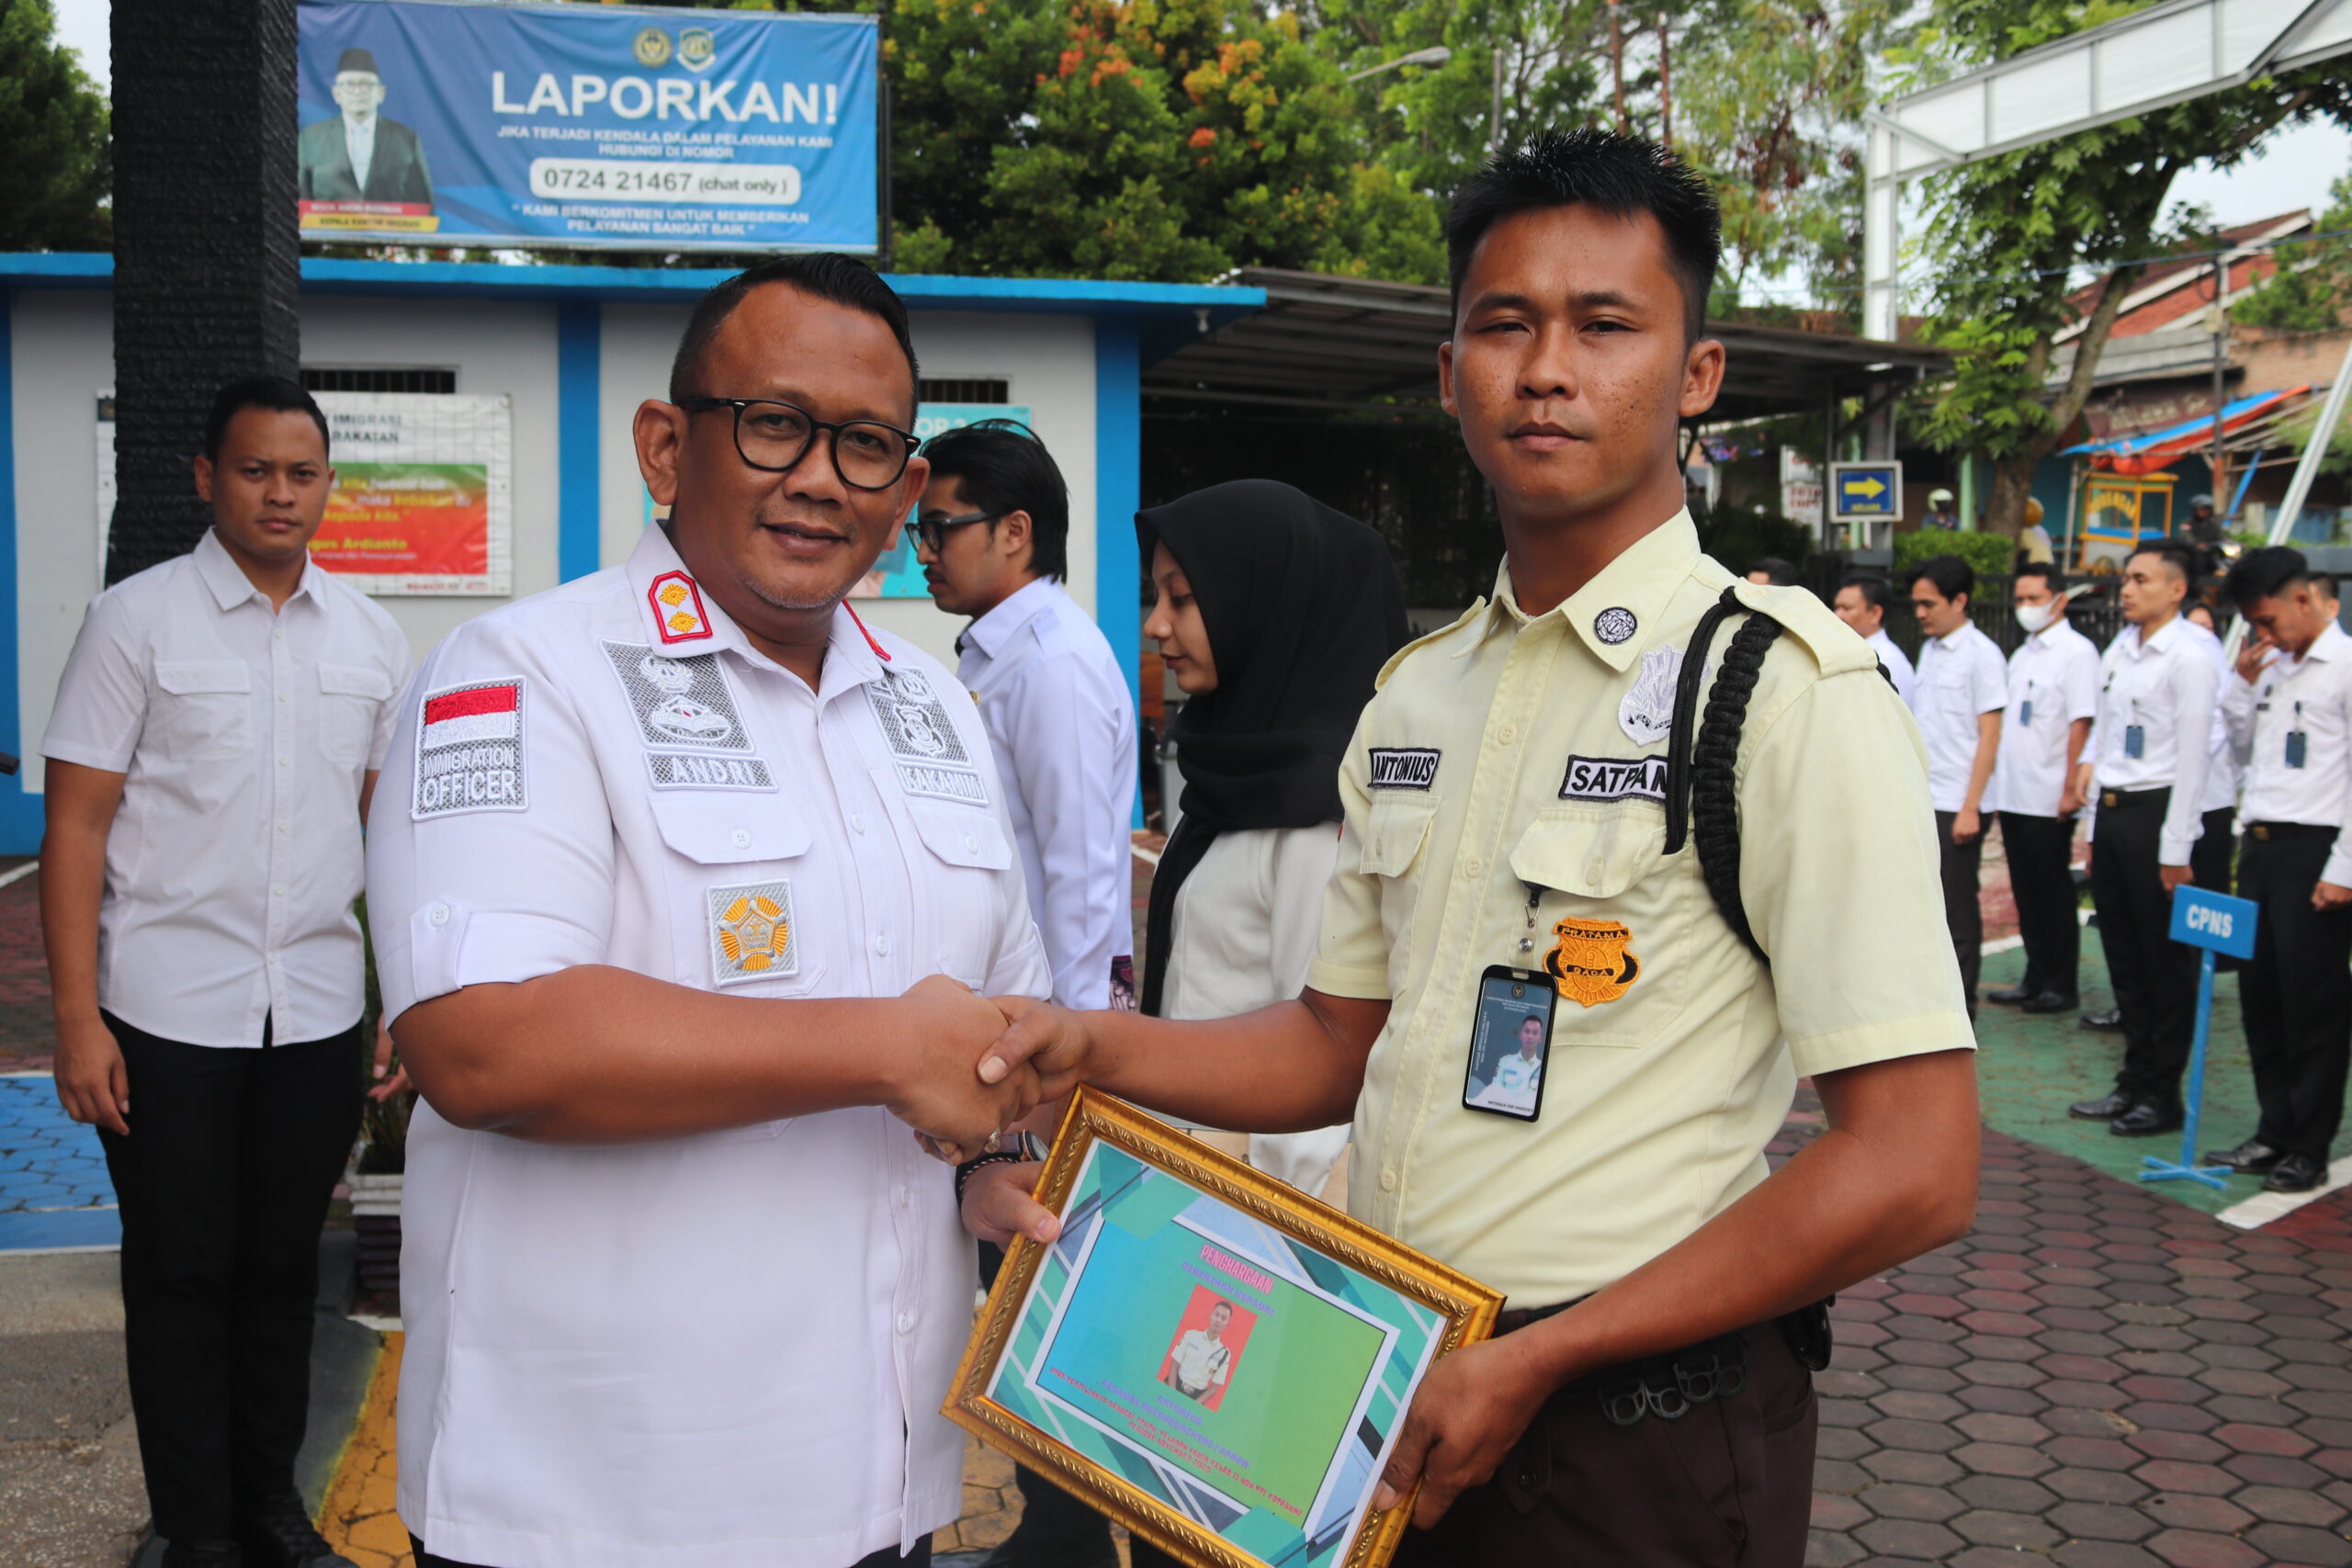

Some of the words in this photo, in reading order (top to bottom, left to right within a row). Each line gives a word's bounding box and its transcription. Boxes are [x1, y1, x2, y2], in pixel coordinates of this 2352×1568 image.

[492, 71, 837, 125] LAPORKAN!
[497, 126, 529, 138] JIKA
[532, 127, 592, 141] TERJADI
[594, 130, 661, 143] KENDALA
[662, 131, 712, 145] DALAM
[715, 133, 796, 147] PELAYANAN
[797, 136, 833, 148] KAMI
[599, 143, 662, 158] HUBUNGI
[665, 146, 680, 158] DI
[683, 147, 734, 159] NOMOR
[544, 169, 605, 190] 0724
[616, 172, 693, 193] 21467
[698, 177, 740, 193] (chat
[744, 179, 776, 196] only
[523, 204, 559, 217] KAMI
[561, 206, 664, 221] BERKOMITMEN
[667, 209, 714, 222] UNTUK
[717, 210, 809, 224] MEMBERIKAN
[567, 220, 650, 234] PELAYANAN
[653, 222, 708, 236] SANGAT
[711, 223, 745, 236] BAIK
[424, 746, 515, 778] IMMIGRATION
[673, 756, 756, 785] ANDRI
[1373, 754, 1435, 783] ANTONIUS
[423, 770, 516, 807] OFFICER
[1562, 927, 1625, 941] PRATAMA
[2187, 903, 2233, 938] CPNS
[1574, 966, 1609, 977] GADA
[1199, 1244, 1274, 1294] PENGHARGAAN
